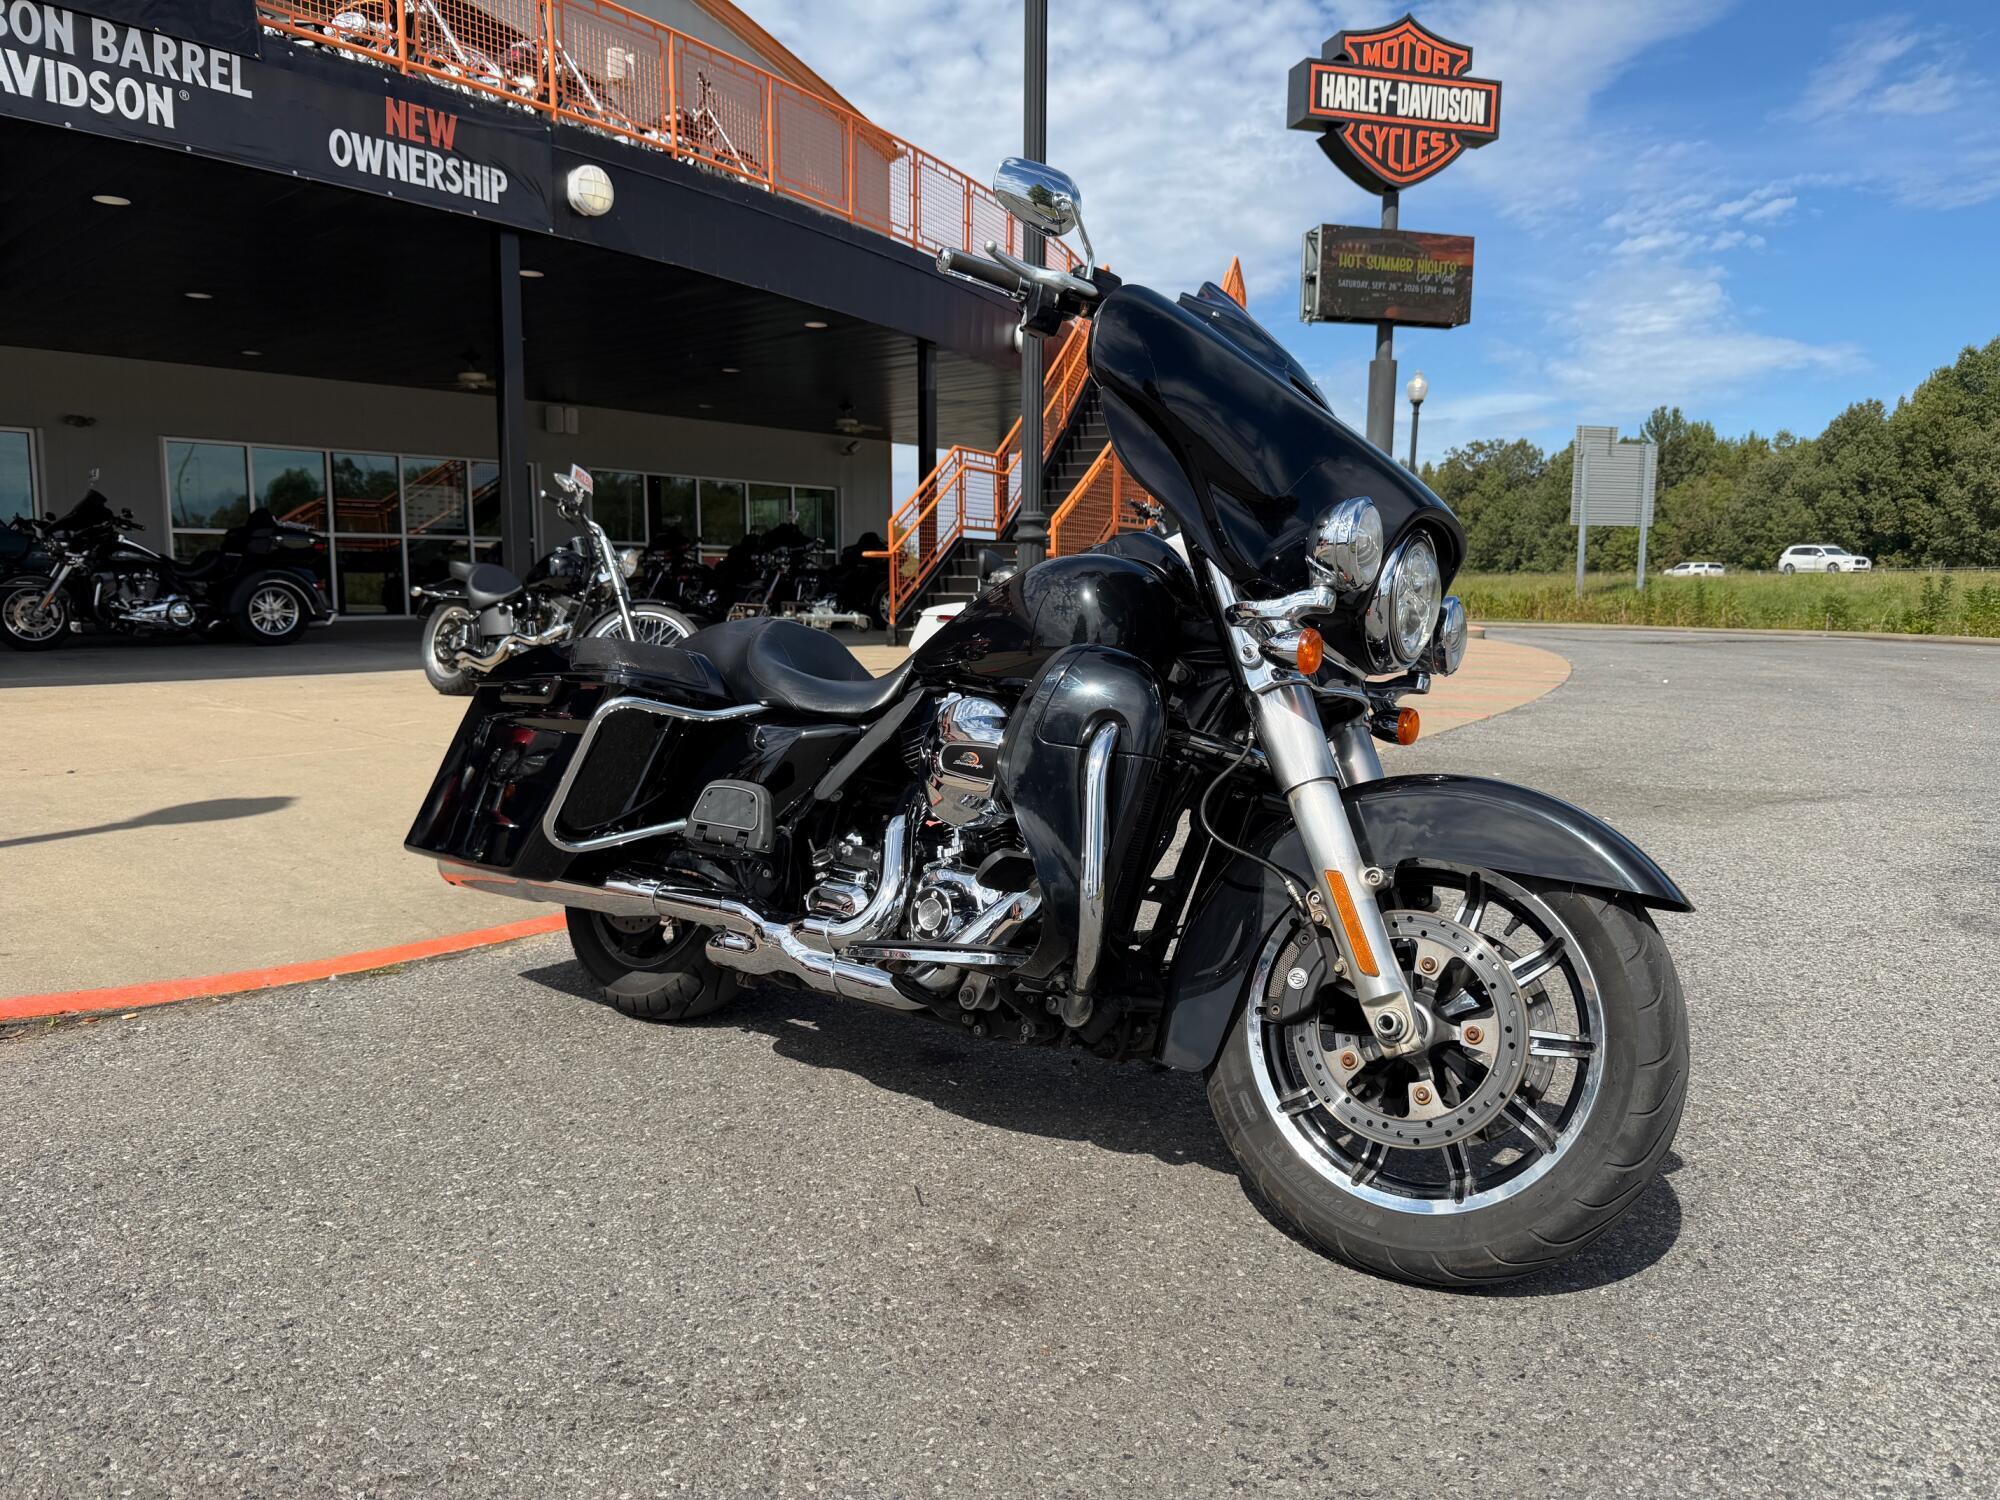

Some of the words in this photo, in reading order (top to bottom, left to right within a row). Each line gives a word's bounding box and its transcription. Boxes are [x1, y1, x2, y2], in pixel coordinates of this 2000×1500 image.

[0, 0, 75, 55] ON
[92, 17, 253, 99] BARREL
[1363, 32, 1450, 76] MOTOR
[385, 96, 458, 151] NEW
[1321, 73, 1486, 125] HARLEY-DAVIDSON
[328, 128, 508, 204] OWNERSHIP
[1358, 124, 1446, 172] CYCLES
[1339, 254, 1361, 269] HOT
[1366, 255, 1414, 273] SUMMER
[1417, 259, 1457, 277] NIGHTS
